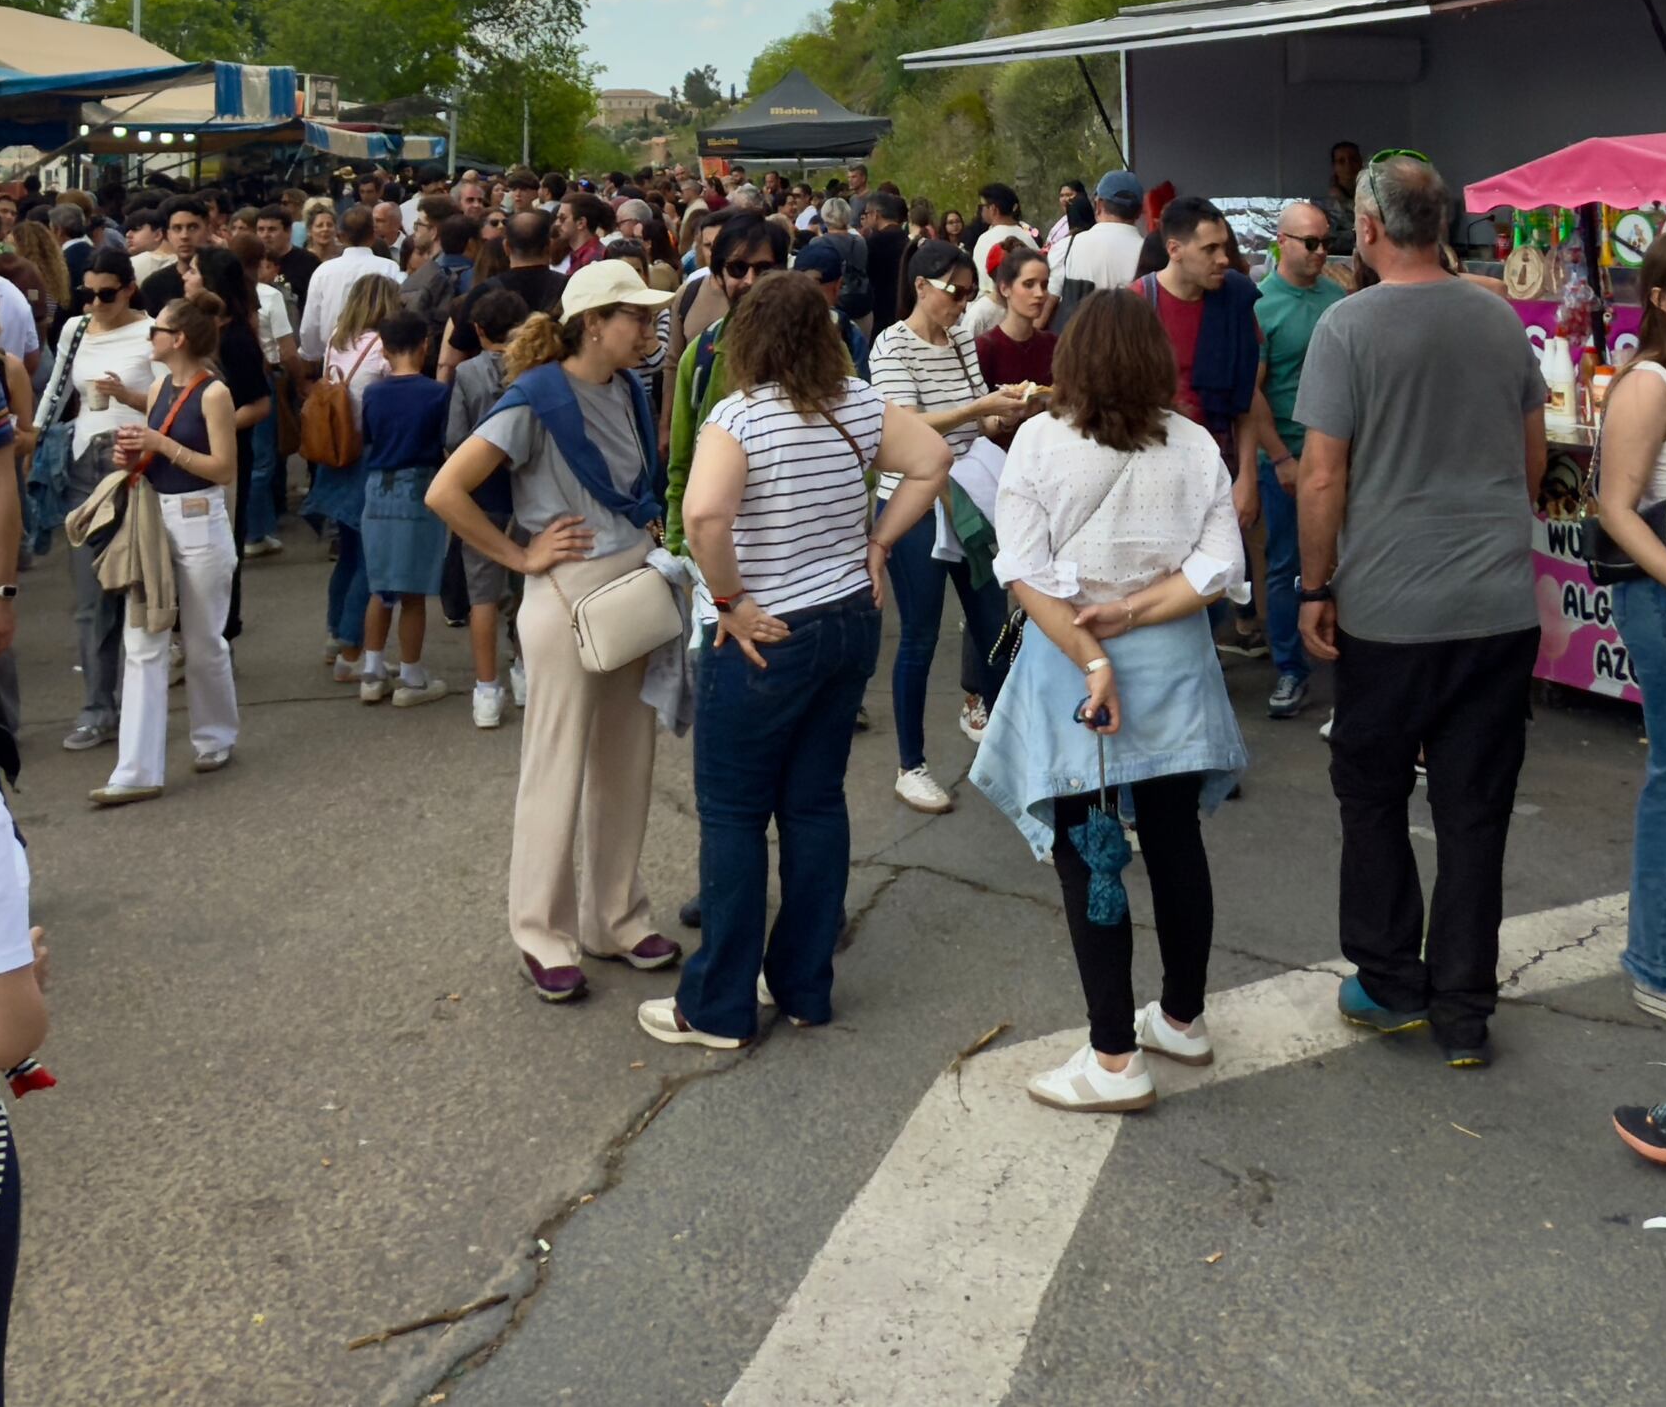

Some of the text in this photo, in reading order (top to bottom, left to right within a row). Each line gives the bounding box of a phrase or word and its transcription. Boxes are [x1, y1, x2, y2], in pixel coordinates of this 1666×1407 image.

[769, 106, 819, 115] Mahou
[1546, 521, 1583, 559] WU
[1563, 583, 1612, 625] ALG
